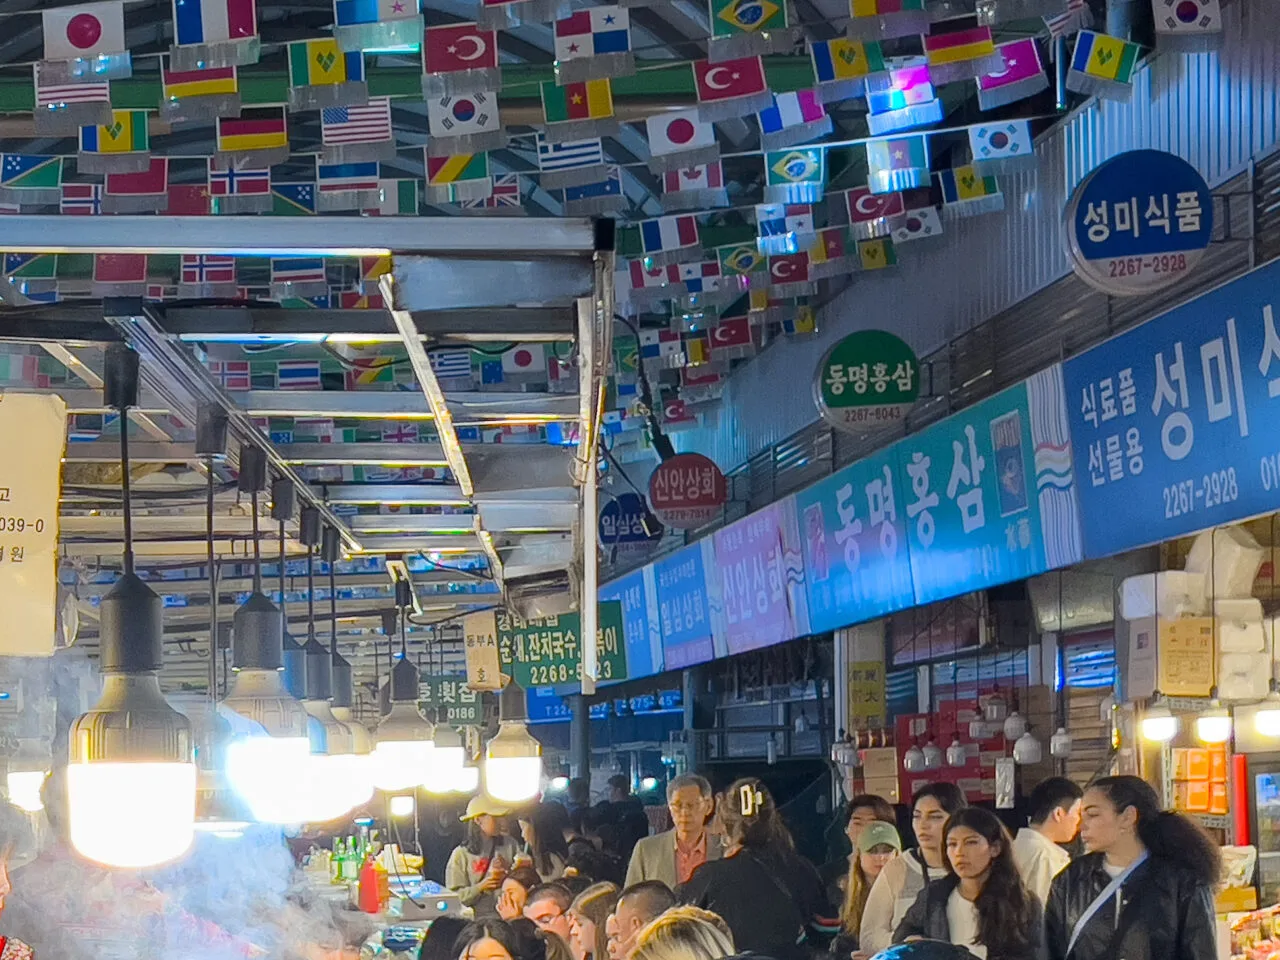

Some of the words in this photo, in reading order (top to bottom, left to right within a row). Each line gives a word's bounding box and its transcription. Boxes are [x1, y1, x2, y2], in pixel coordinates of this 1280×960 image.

[1083, 191, 1202, 243] 성미식품
[1109, 253, 1187, 278] 2267-2928
[825, 360, 915, 395] 동명홍삼
[1081, 367, 1137, 429] 식료품
[1088, 427, 1144, 488] 선물용
[655, 466, 716, 502] 신안상회
[834, 424, 986, 574] 동명홍삼
[1163, 466, 1239, 519] 2267-2928
[601, 513, 646, 536] 일심상
[723, 545, 784, 625] 신안상회
